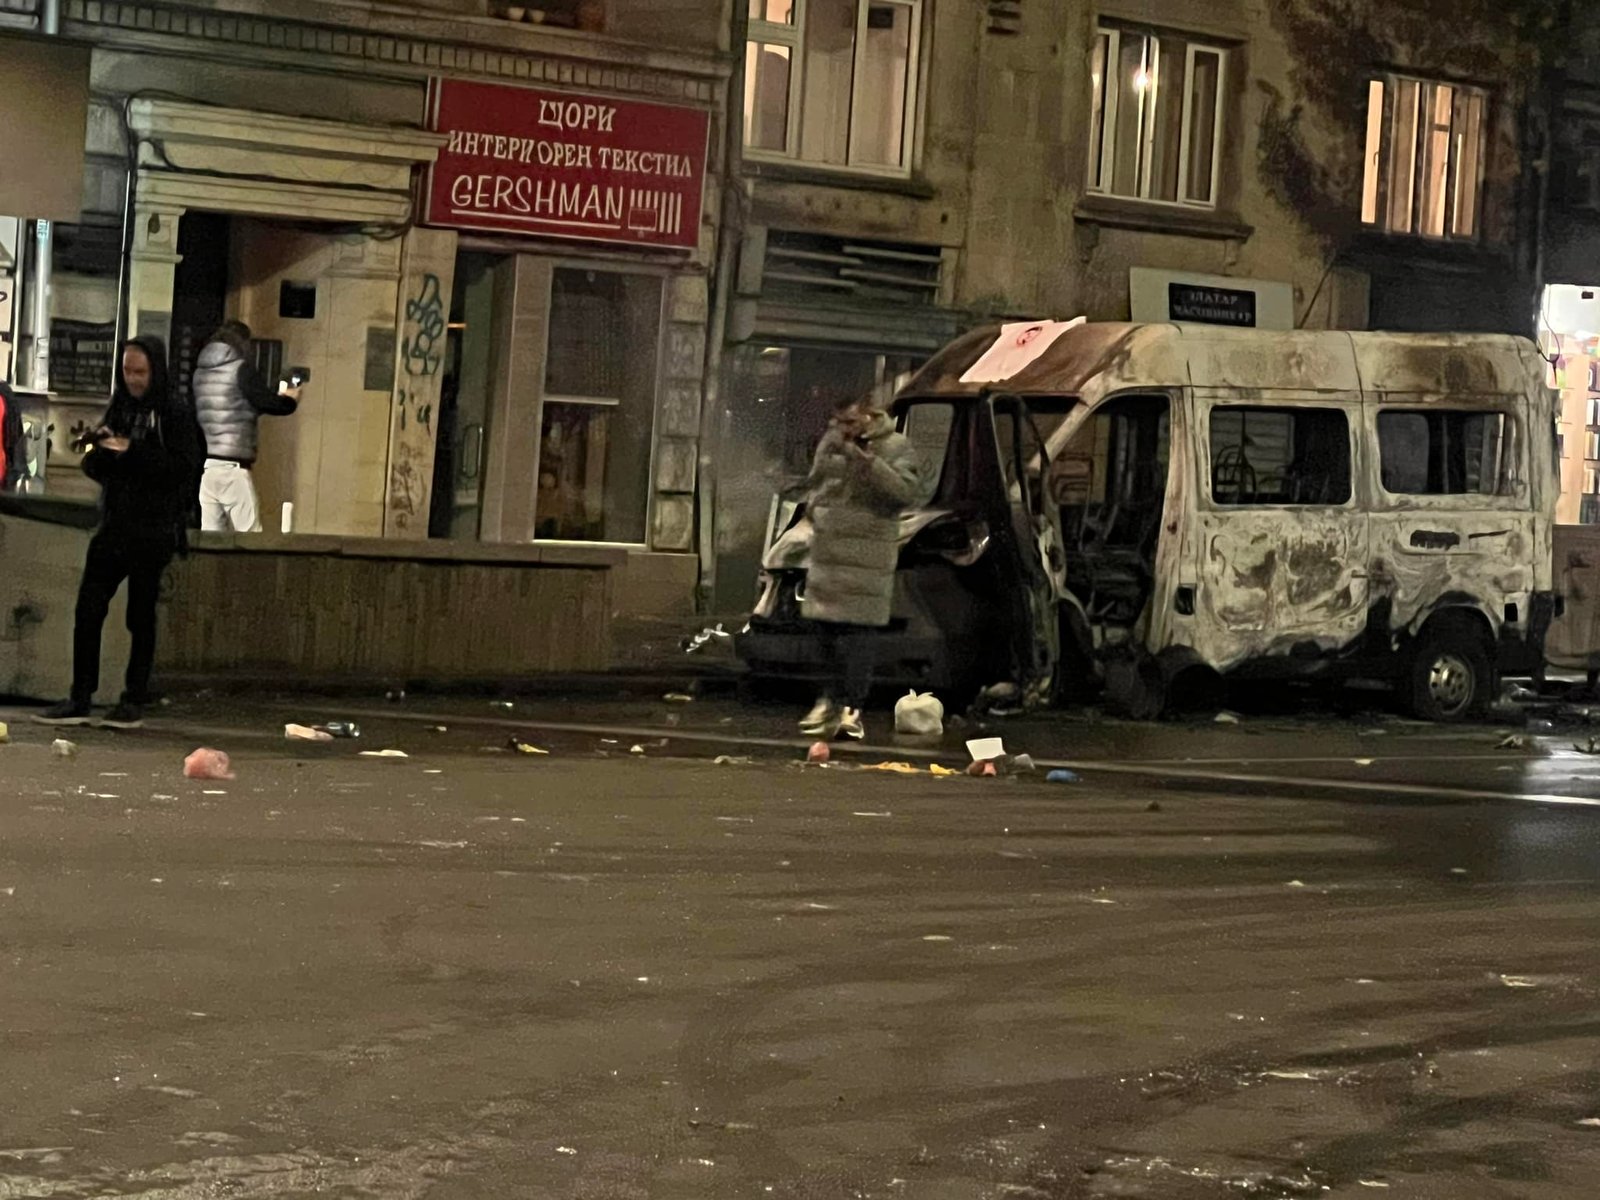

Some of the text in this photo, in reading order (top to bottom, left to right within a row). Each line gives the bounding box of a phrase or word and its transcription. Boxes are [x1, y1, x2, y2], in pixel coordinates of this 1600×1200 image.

[538, 99, 616, 132] ЩОРИ
[448, 130, 692, 177] ИНТЕРИОРЕН ТЕКСТИЛ
[451, 175, 623, 220] GERSHMAN
